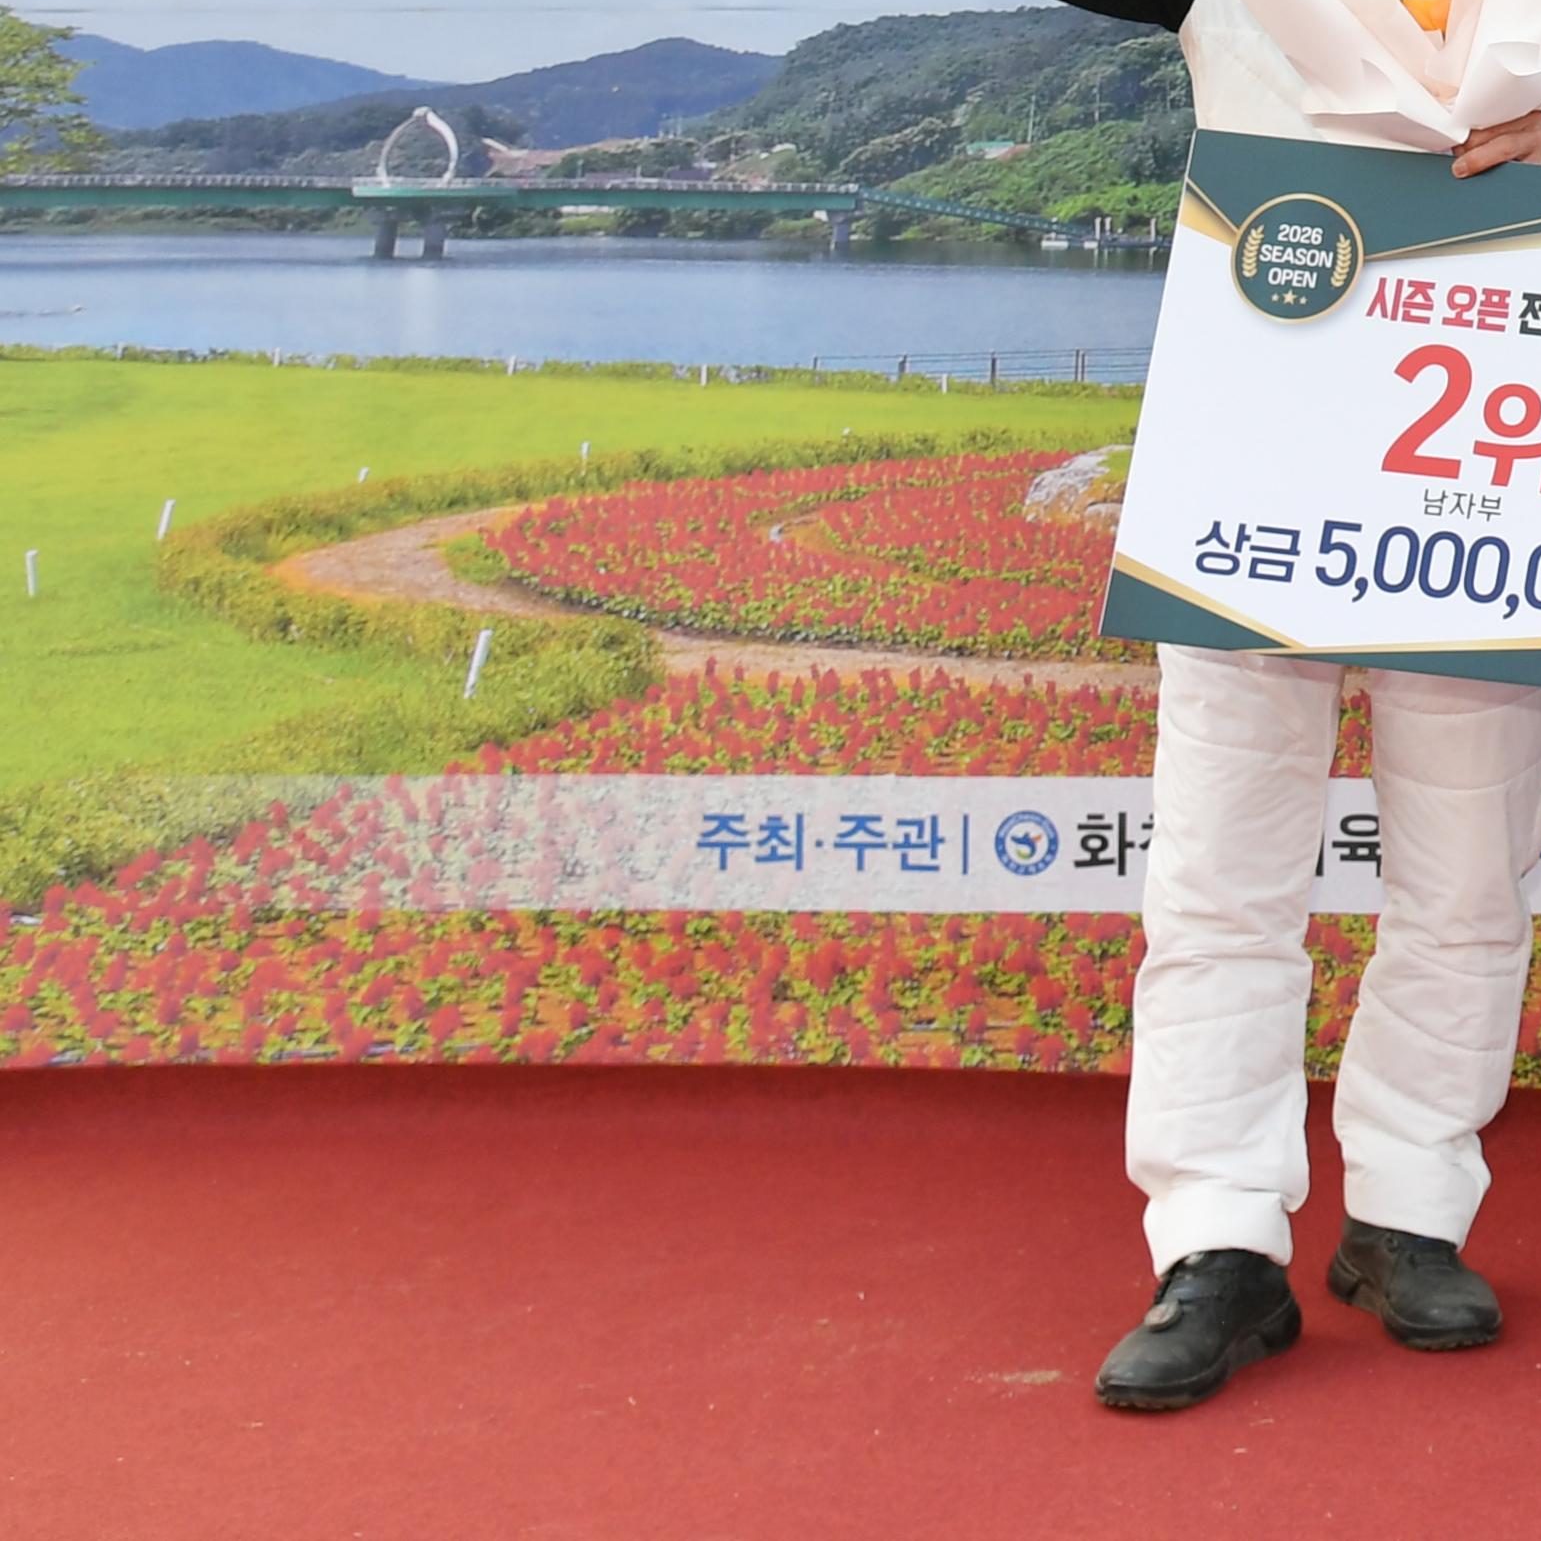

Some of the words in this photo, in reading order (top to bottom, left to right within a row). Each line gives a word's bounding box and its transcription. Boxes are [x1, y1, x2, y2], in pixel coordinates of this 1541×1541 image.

[1277, 223, 1324, 246] 2026
[1259, 244, 1334, 269] SEASON
[1267, 266, 1318, 289] OPEN
[1365, 275, 1437, 325] 시즌
[1441, 284, 1512, 333] 오픈
[1422, 487, 1503, 523] 남자부
[1194, 520, 1302, 583] 상금
